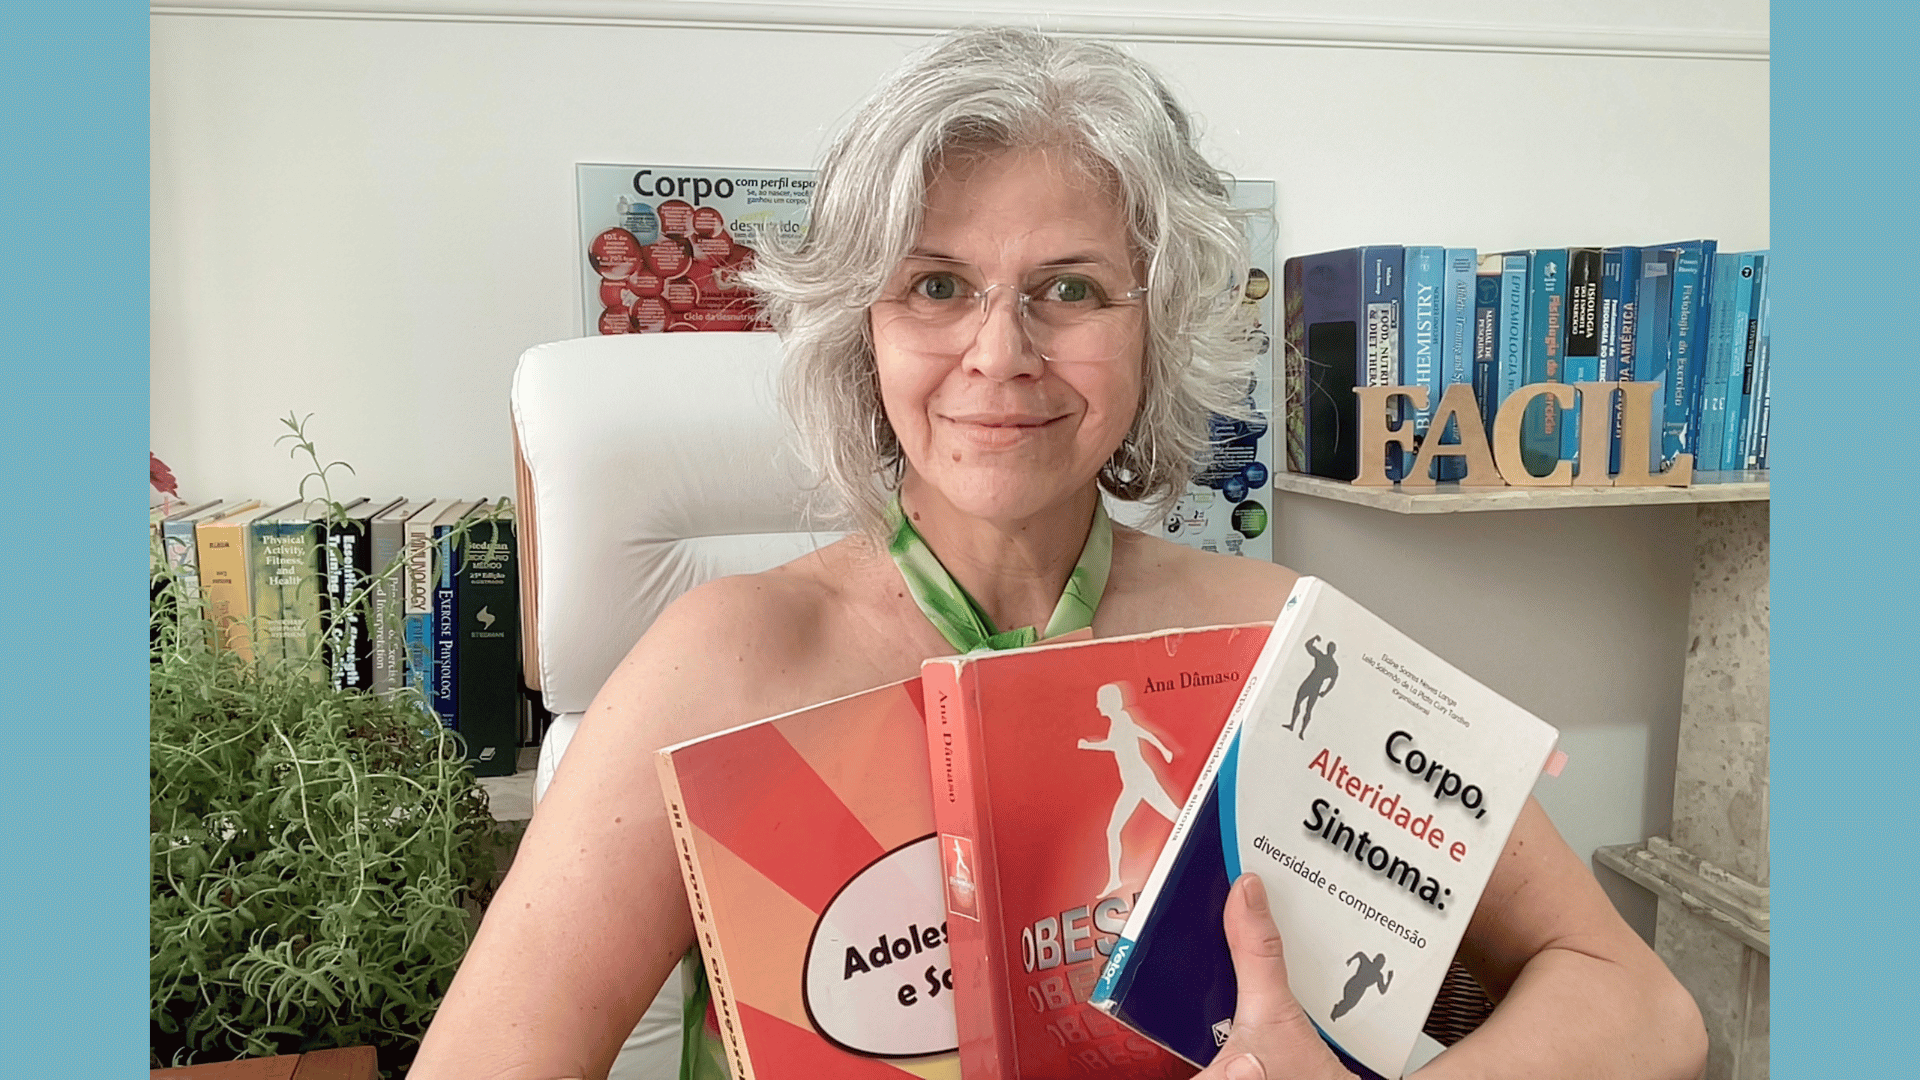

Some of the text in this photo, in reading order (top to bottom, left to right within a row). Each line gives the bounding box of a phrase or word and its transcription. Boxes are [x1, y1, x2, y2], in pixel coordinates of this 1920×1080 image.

[633, 170, 734, 206] Corpo
[735, 177, 817, 190] com perfil espo
[1369, 310, 1378, 320] &
[1574, 286, 1580, 298] DO
[1580, 286, 1586, 298] DO
[1585, 282, 1596, 338] FISIOLOGIA
[1678, 284, 1693, 337] Fisiologia
[1369, 323, 1378, 349] DIET
[1381, 309, 1390, 343] FOOD,
[1477, 319, 1485, 359] PESQUISA
[1485, 310, 1493, 358] MANUAL DE
[1507, 275, 1521, 375] EPIDEMIOLOGIA
[1544, 295, 1560, 356] Fisiologia
[1601, 299, 1611, 345] FISIOLOGIA
[1619, 302, 1634, 363] AMÉRICA
[1600, 345, 1608, 357] DO
[1677, 340, 1688, 354] do
[1351, 381, 1693, 488] FACIL
[263, 535, 305, 545] Physical
[263, 545, 306, 556] Activity,
[266, 556, 304, 566] Fitness,
[276, 565, 295, 575] and
[439, 590, 454, 637] EXERCISE
[439, 640, 453, 700] PHYSIOLOGY
[1143, 671, 1240, 694] Ana Dâmaso
[1362, 653, 1375, 667] Leila
[1401, 681, 1409, 689] de
[1409, 686, 1418, 695] La
[1433, 701, 1448, 715] Cury
[1448, 709, 1470, 728] Tardivo
[1381, 653, 1457, 707] Elaine Soares Neves Lange
[939, 690, 956, 803] Ana Dâmaso
[1202, 719, 1234, 781] alteridade
[1385, 730, 1488, 820] Corpo,
[1172, 794, 1198, 841] sintoma
[1308, 748, 1467, 863] Alteridade e
[1303, 798, 1452, 911] Sintoma:
[1253, 835, 1427, 950] diversidade e compreensão
[1022, 893, 1140, 974] OBES
[1101, 945, 1129, 989] Vetor
[897, 983, 918, 1007] e
